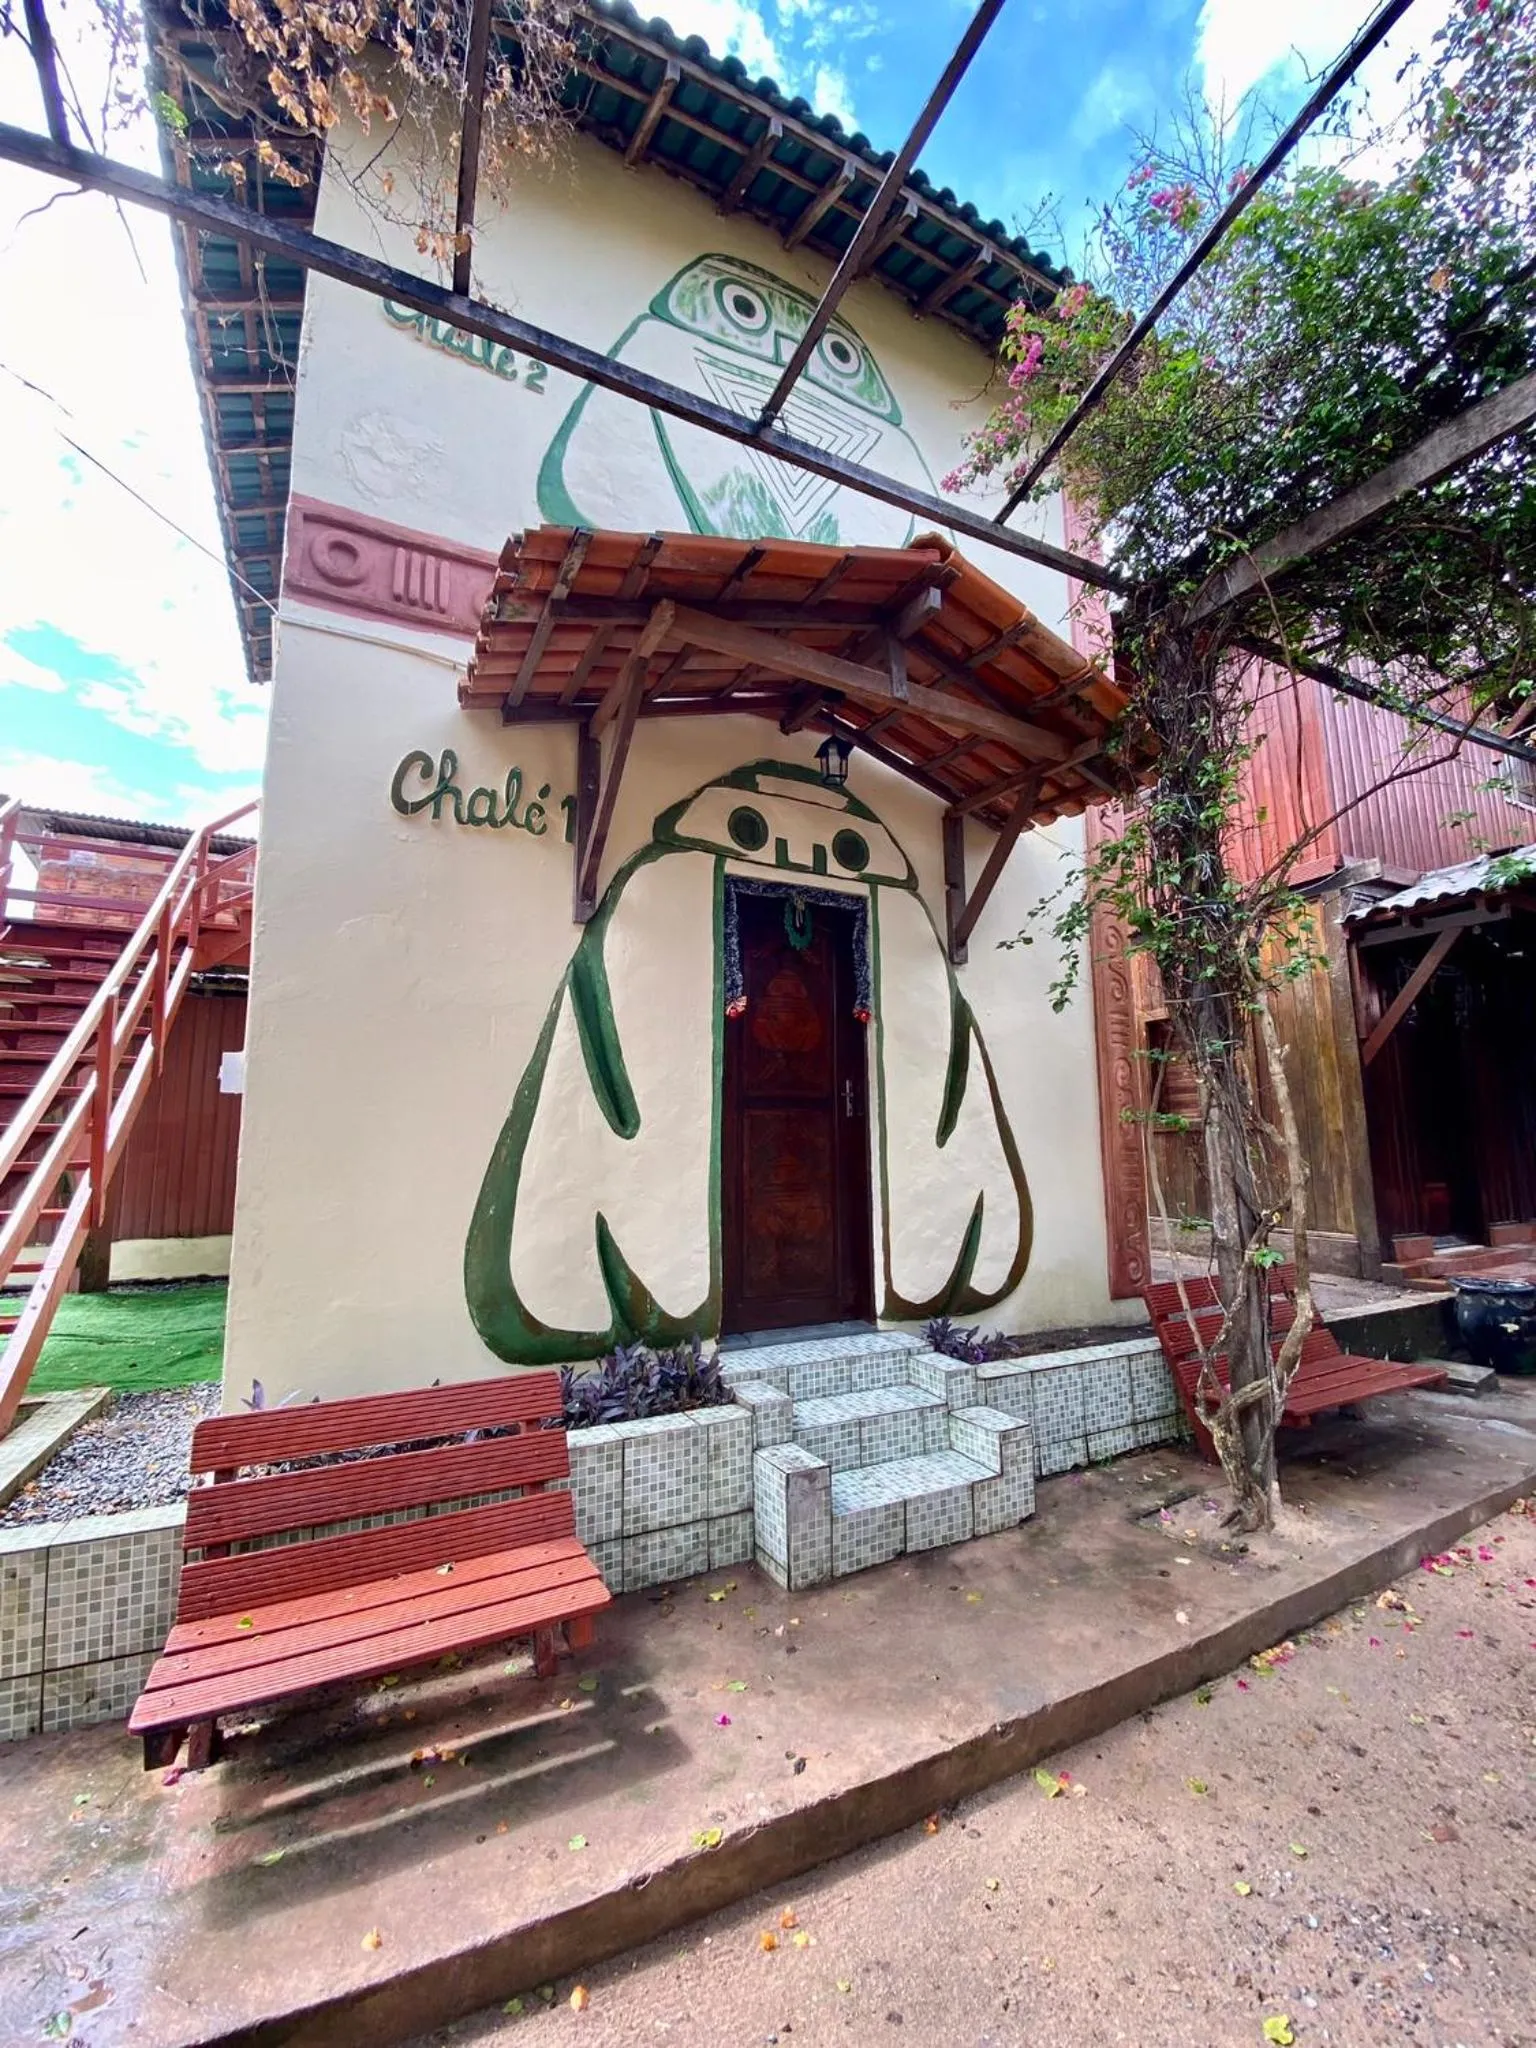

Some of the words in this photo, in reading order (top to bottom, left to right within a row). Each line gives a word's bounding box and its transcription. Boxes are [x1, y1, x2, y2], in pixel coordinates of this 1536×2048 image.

[525, 359, 549, 395] 2
[391, 748, 551, 835] Chalé
[561, 794, 577, 843] 1
